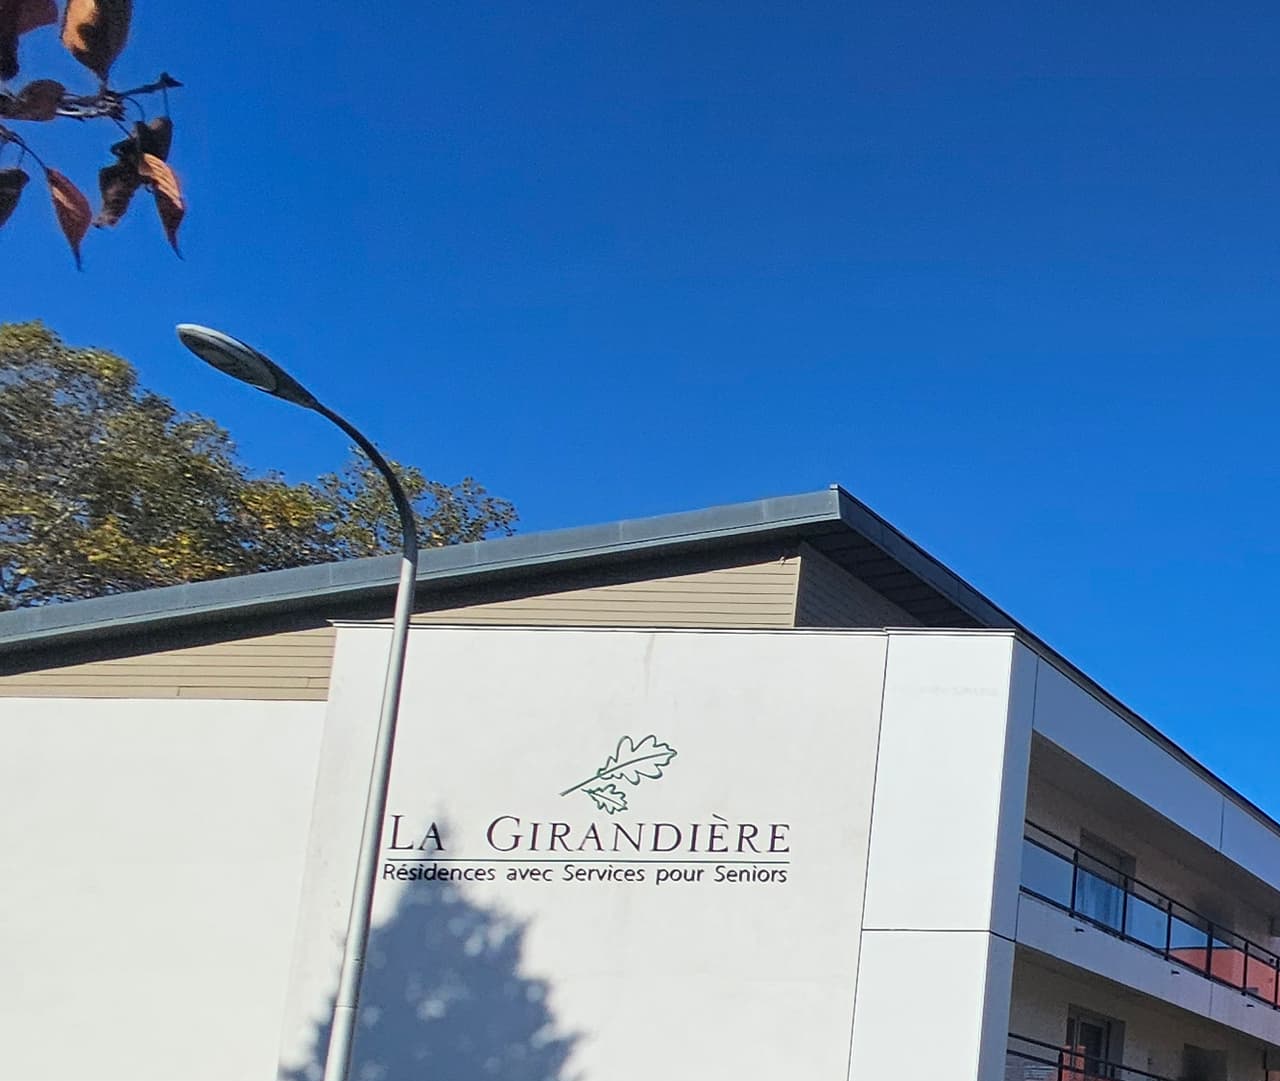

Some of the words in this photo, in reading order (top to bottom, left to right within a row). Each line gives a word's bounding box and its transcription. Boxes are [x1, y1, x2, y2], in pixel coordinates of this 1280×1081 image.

[388, 815, 446, 851] LA
[486, 813, 791, 854] GIRANDIÈRE
[383, 863, 496, 882] Résidences
[506, 867, 553, 882] avec
[562, 864, 645, 883] Services
[656, 867, 705, 886] pour
[714, 865, 788, 884] Seniors
